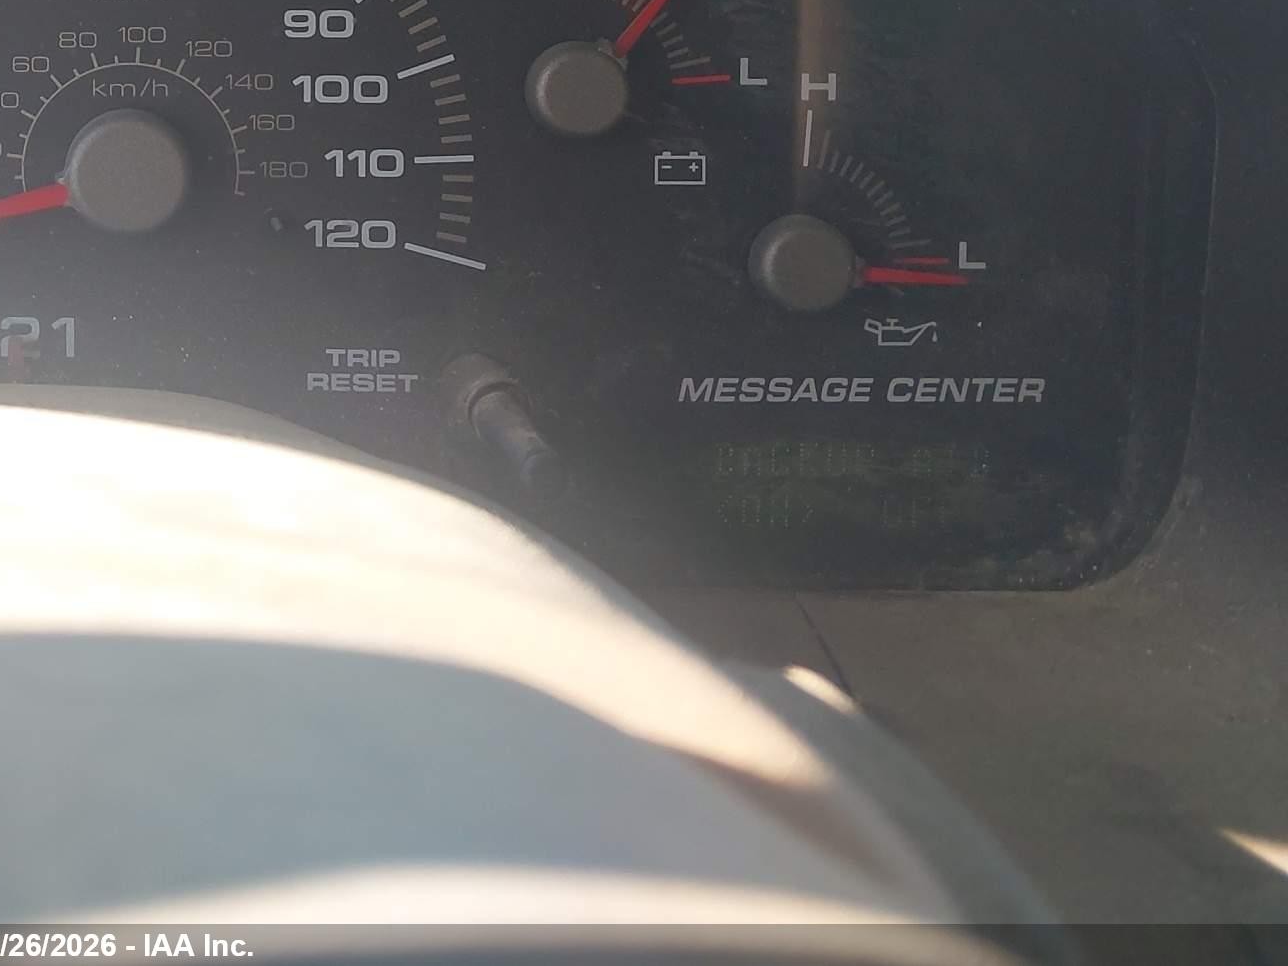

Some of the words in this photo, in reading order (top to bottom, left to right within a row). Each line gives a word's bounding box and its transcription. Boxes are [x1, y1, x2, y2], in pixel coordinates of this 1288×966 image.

[283, 9, 355, 38] 90
[58, 32, 97, 48] 80
[118, 26, 166, 43] 100
[185, 40, 233, 57] 120
[12, 56, 49, 72] 60
[739, 58, 768, 85] L
[92, 79, 168, 97] km/h
[225, 74, 273, 90] 140
[292, 75, 389, 103] 100
[801, 73, 837, 100] H
[248, 114, 295, 130] 160
[259, 162, 308, 178] 180
[324, 149, 405, 177] 110
[304, 220, 397, 248] 120
[958, 242, 986, 269] L
[325, 348, 401, 367] TRIP
[306, 372, 419, 393] RESET
[678, 378, 874, 403] MESSAGE
[886, 378, 1046, 403] CENTER
